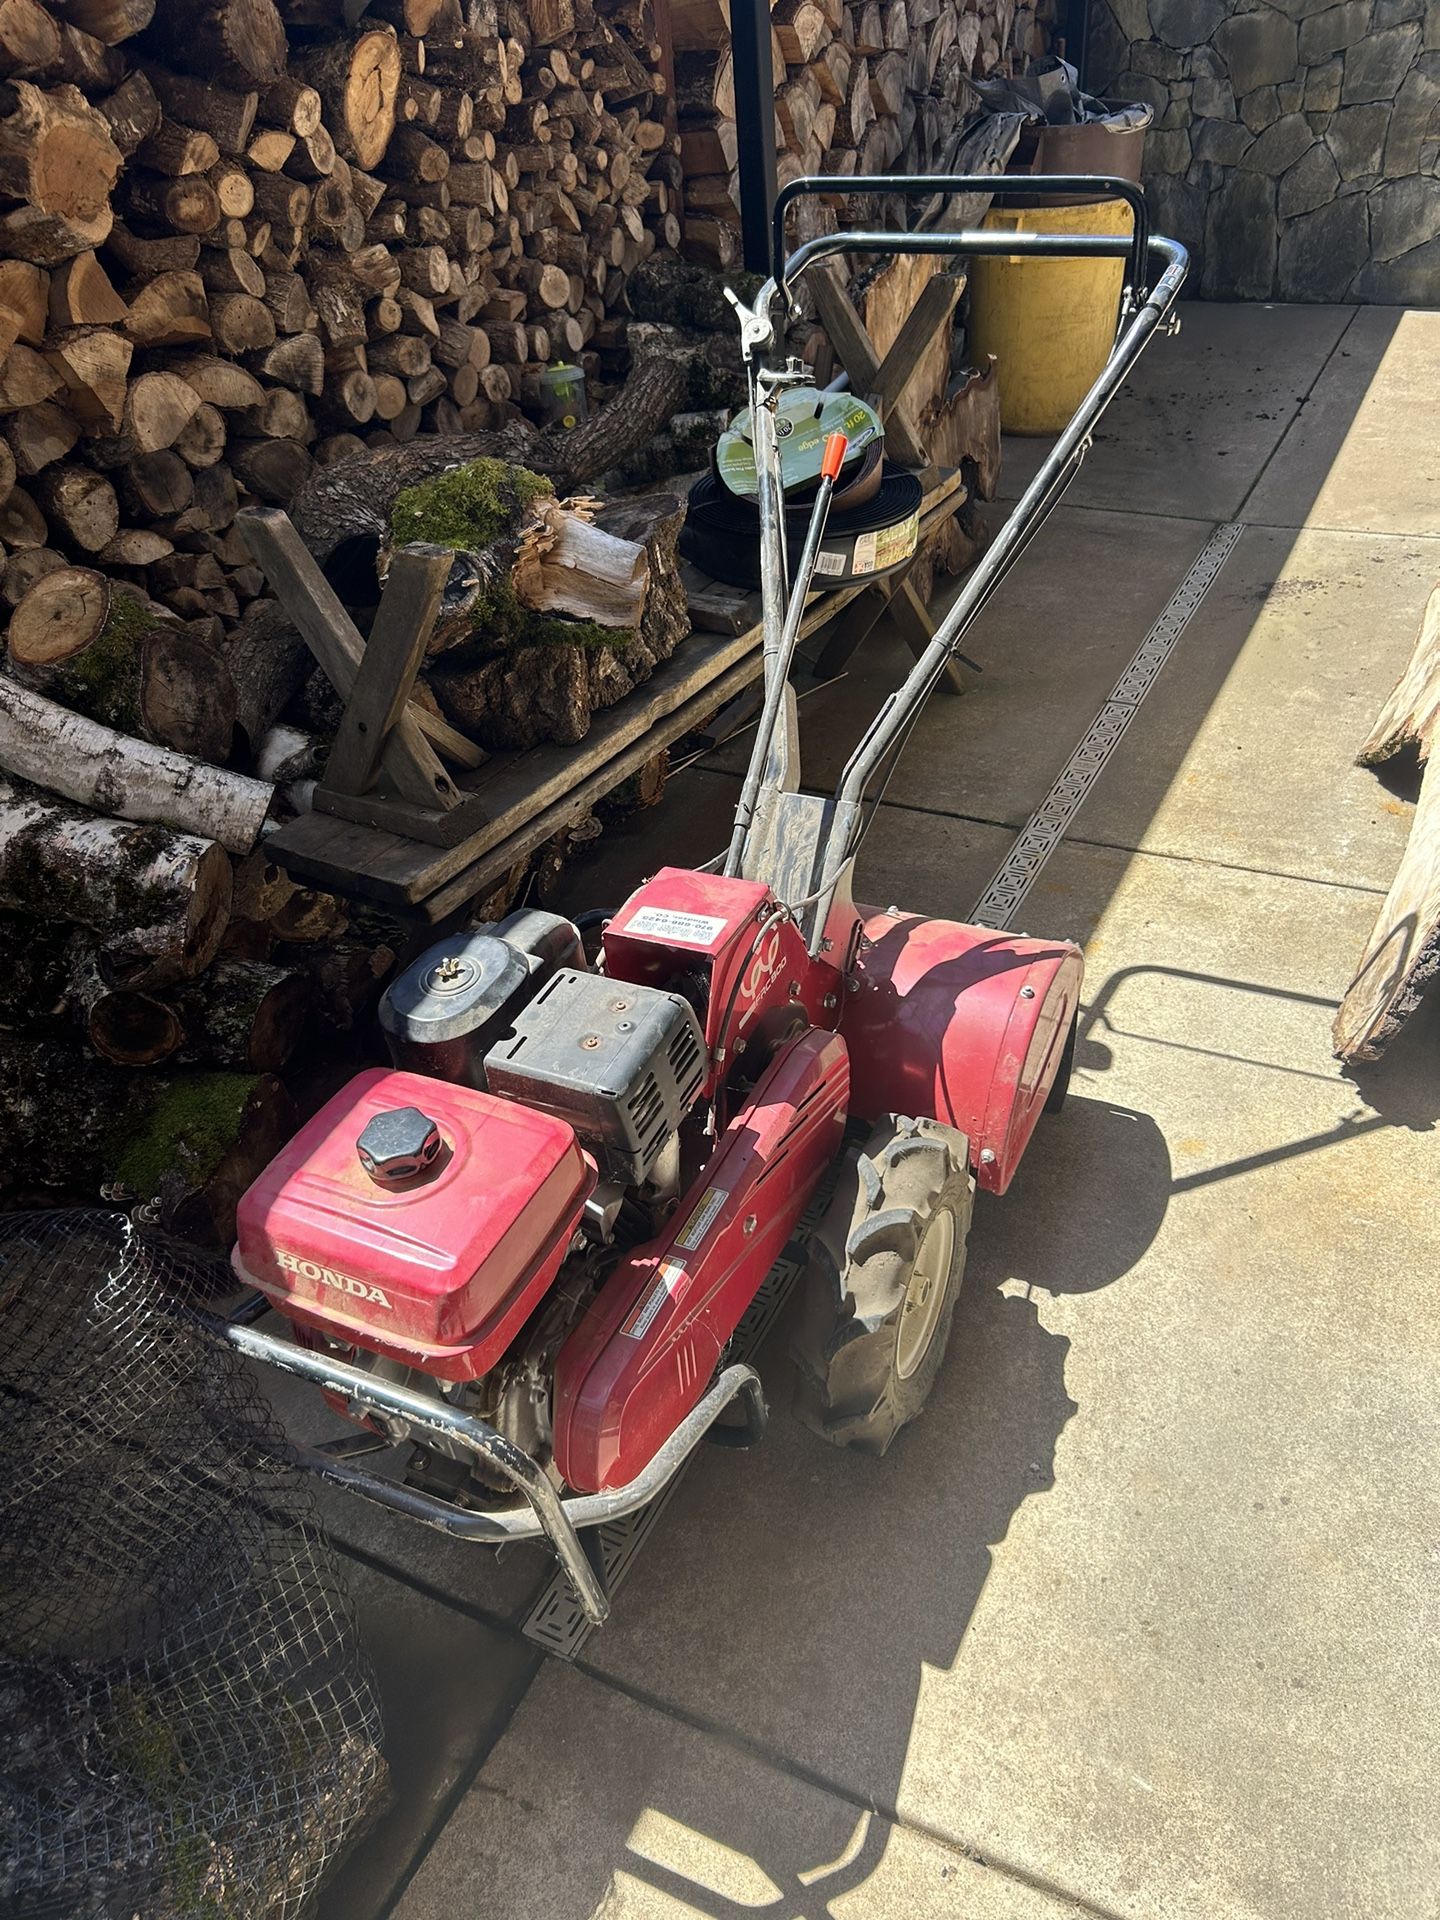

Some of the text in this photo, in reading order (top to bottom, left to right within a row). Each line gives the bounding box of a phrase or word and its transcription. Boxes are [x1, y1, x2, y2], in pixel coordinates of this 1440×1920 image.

[853, 411, 866, 424] 20
[798, 438, 820, 452] edge
[275, 1250, 393, 1310] HONDA
